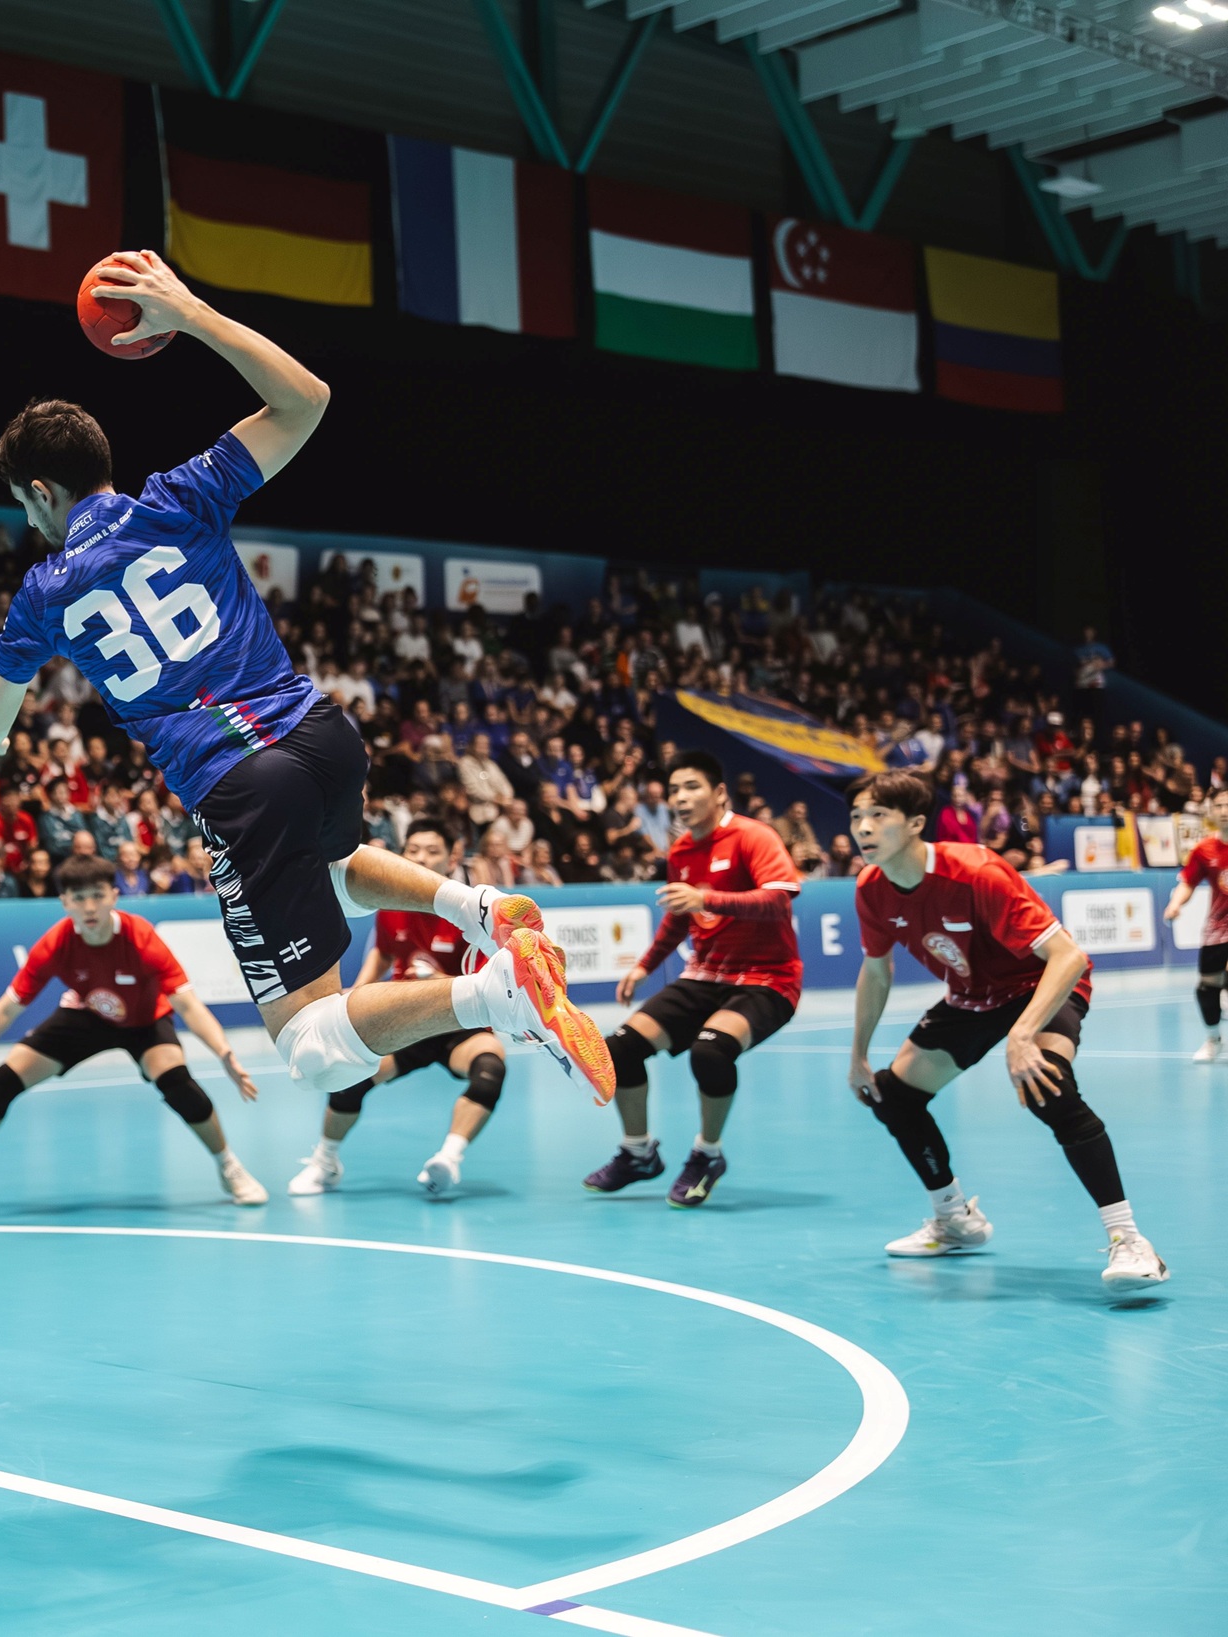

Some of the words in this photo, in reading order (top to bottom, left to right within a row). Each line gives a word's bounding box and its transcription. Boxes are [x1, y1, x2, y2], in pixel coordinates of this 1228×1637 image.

[63, 545, 221, 703] 36
[556, 924, 598, 945] FONDS
[565, 949, 599, 973] PORT
